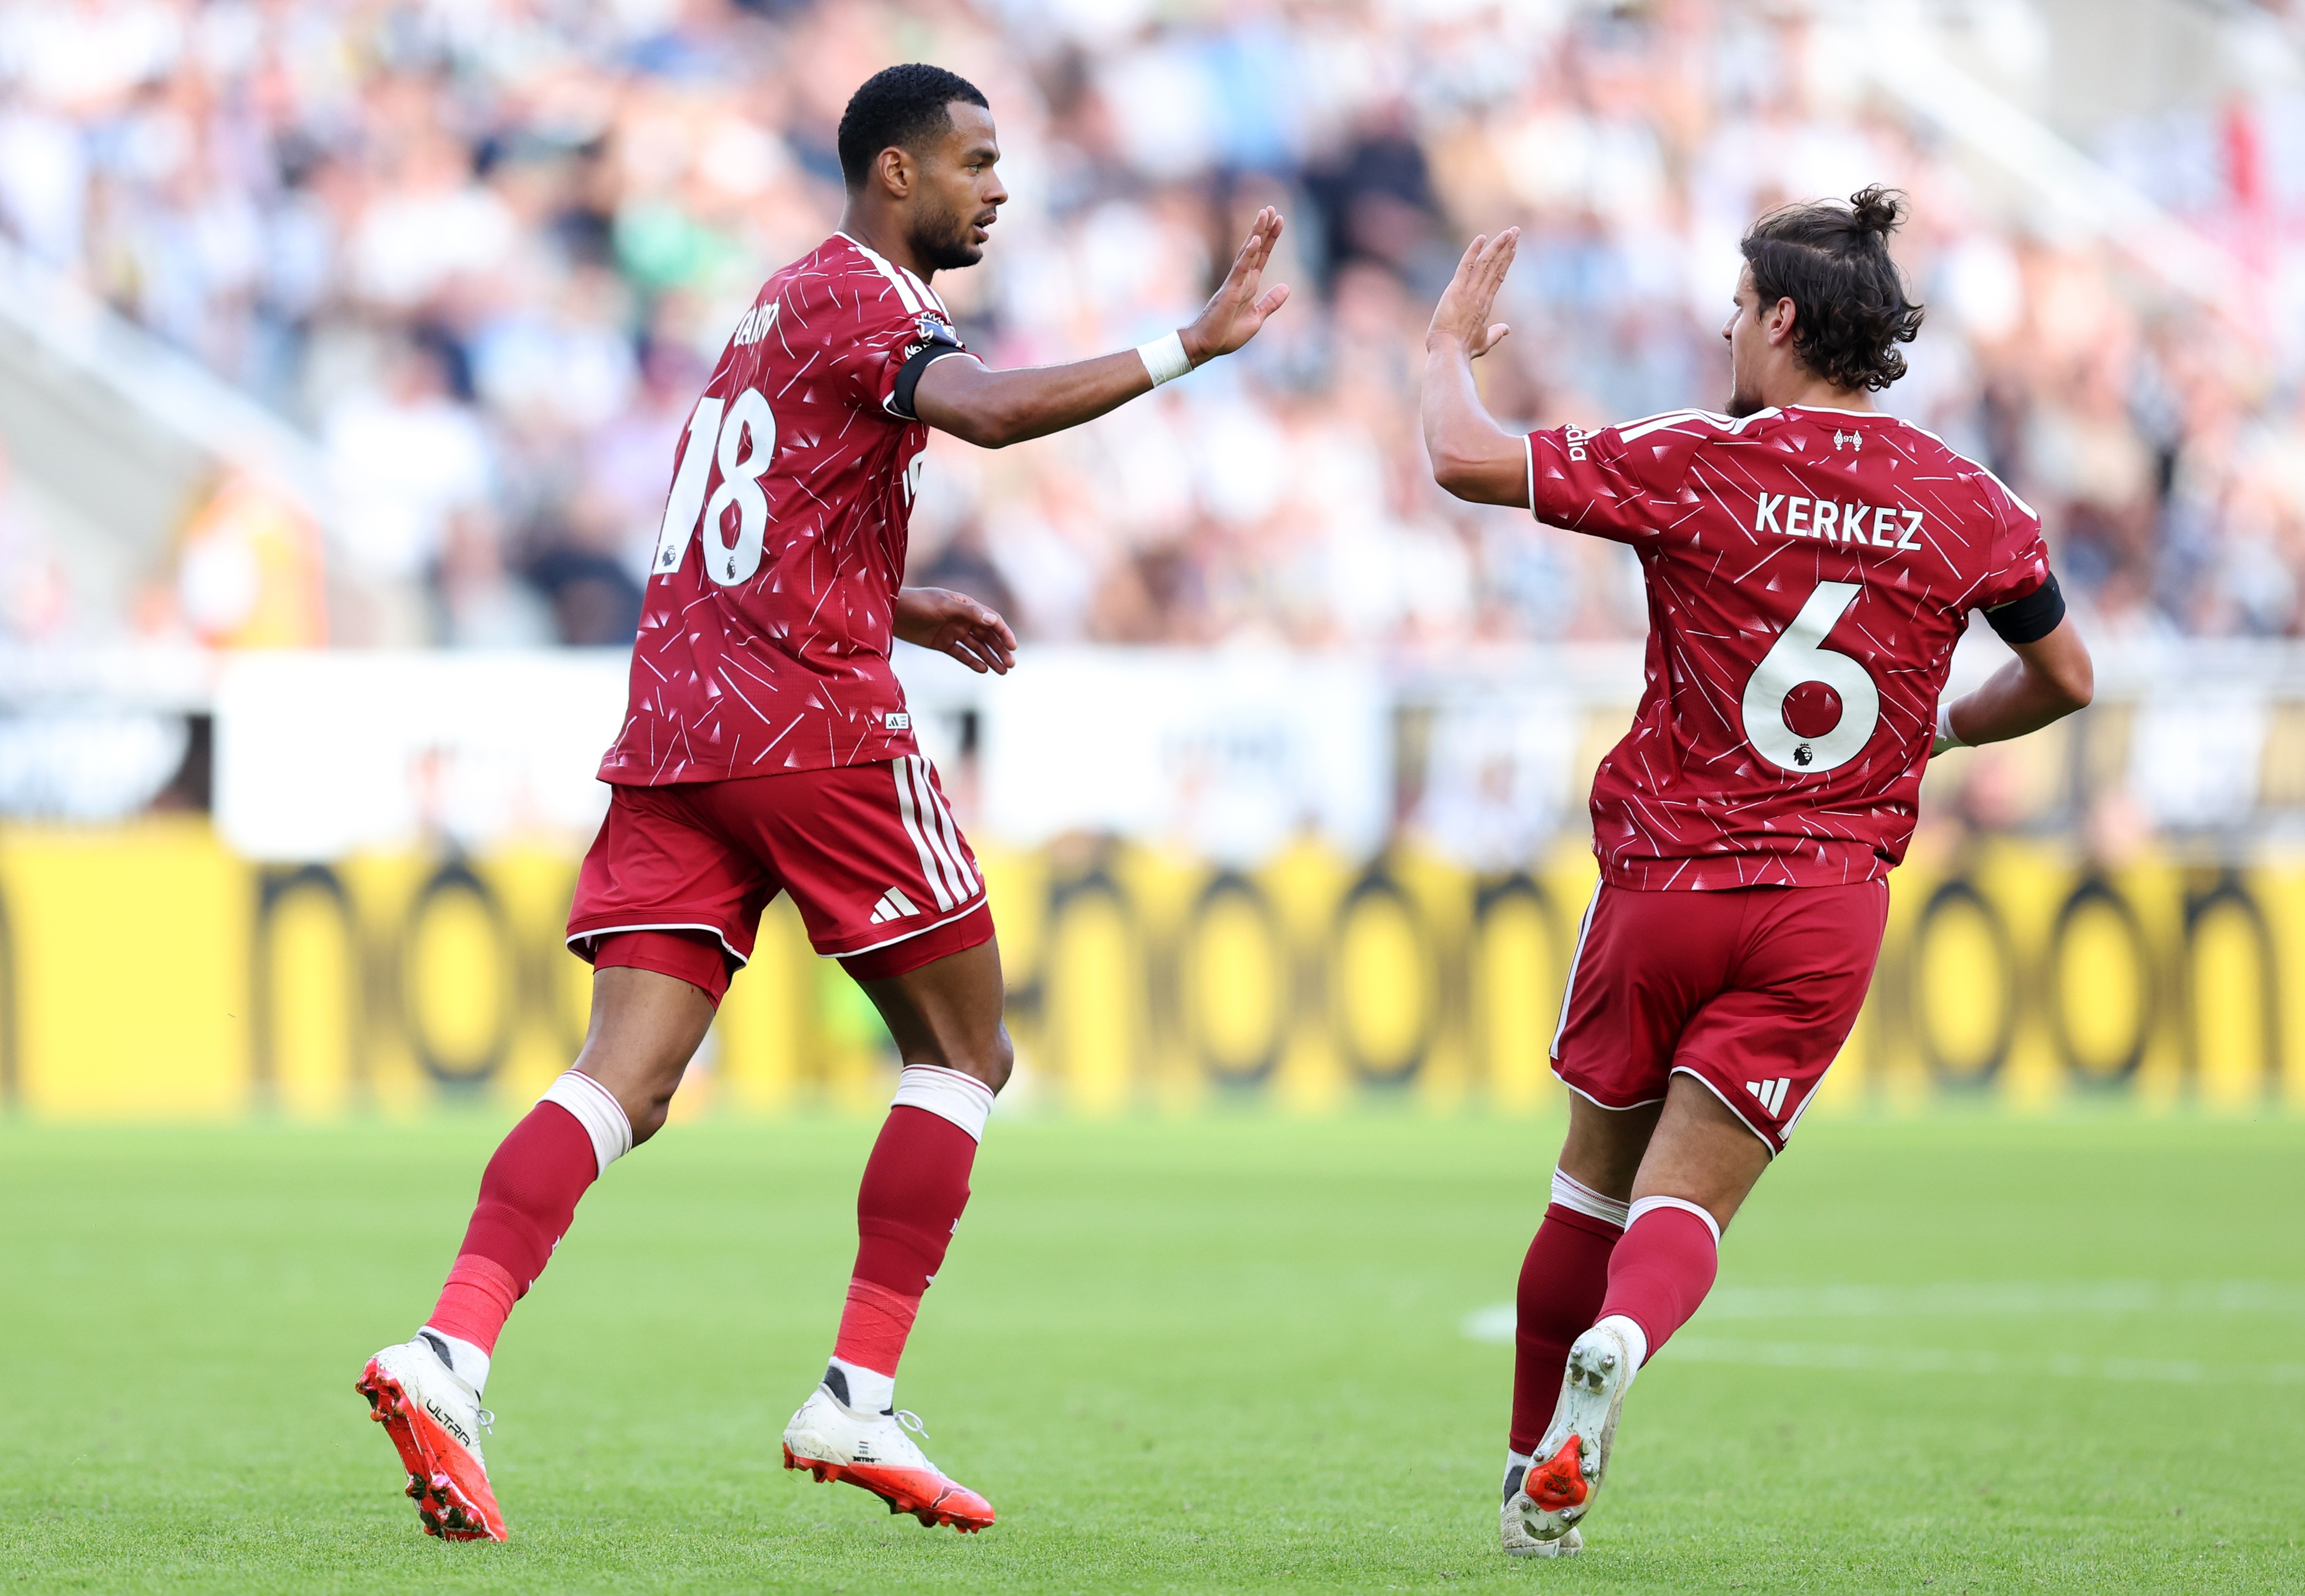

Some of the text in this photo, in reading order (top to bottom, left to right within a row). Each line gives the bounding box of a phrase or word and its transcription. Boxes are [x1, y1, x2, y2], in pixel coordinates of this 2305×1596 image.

[652, 386, 777, 587] 18
[1755, 491, 1924, 551] KERKEZ
[1741, 580, 1880, 774] 6
[426, 1398, 470, 1446] ULTRA
